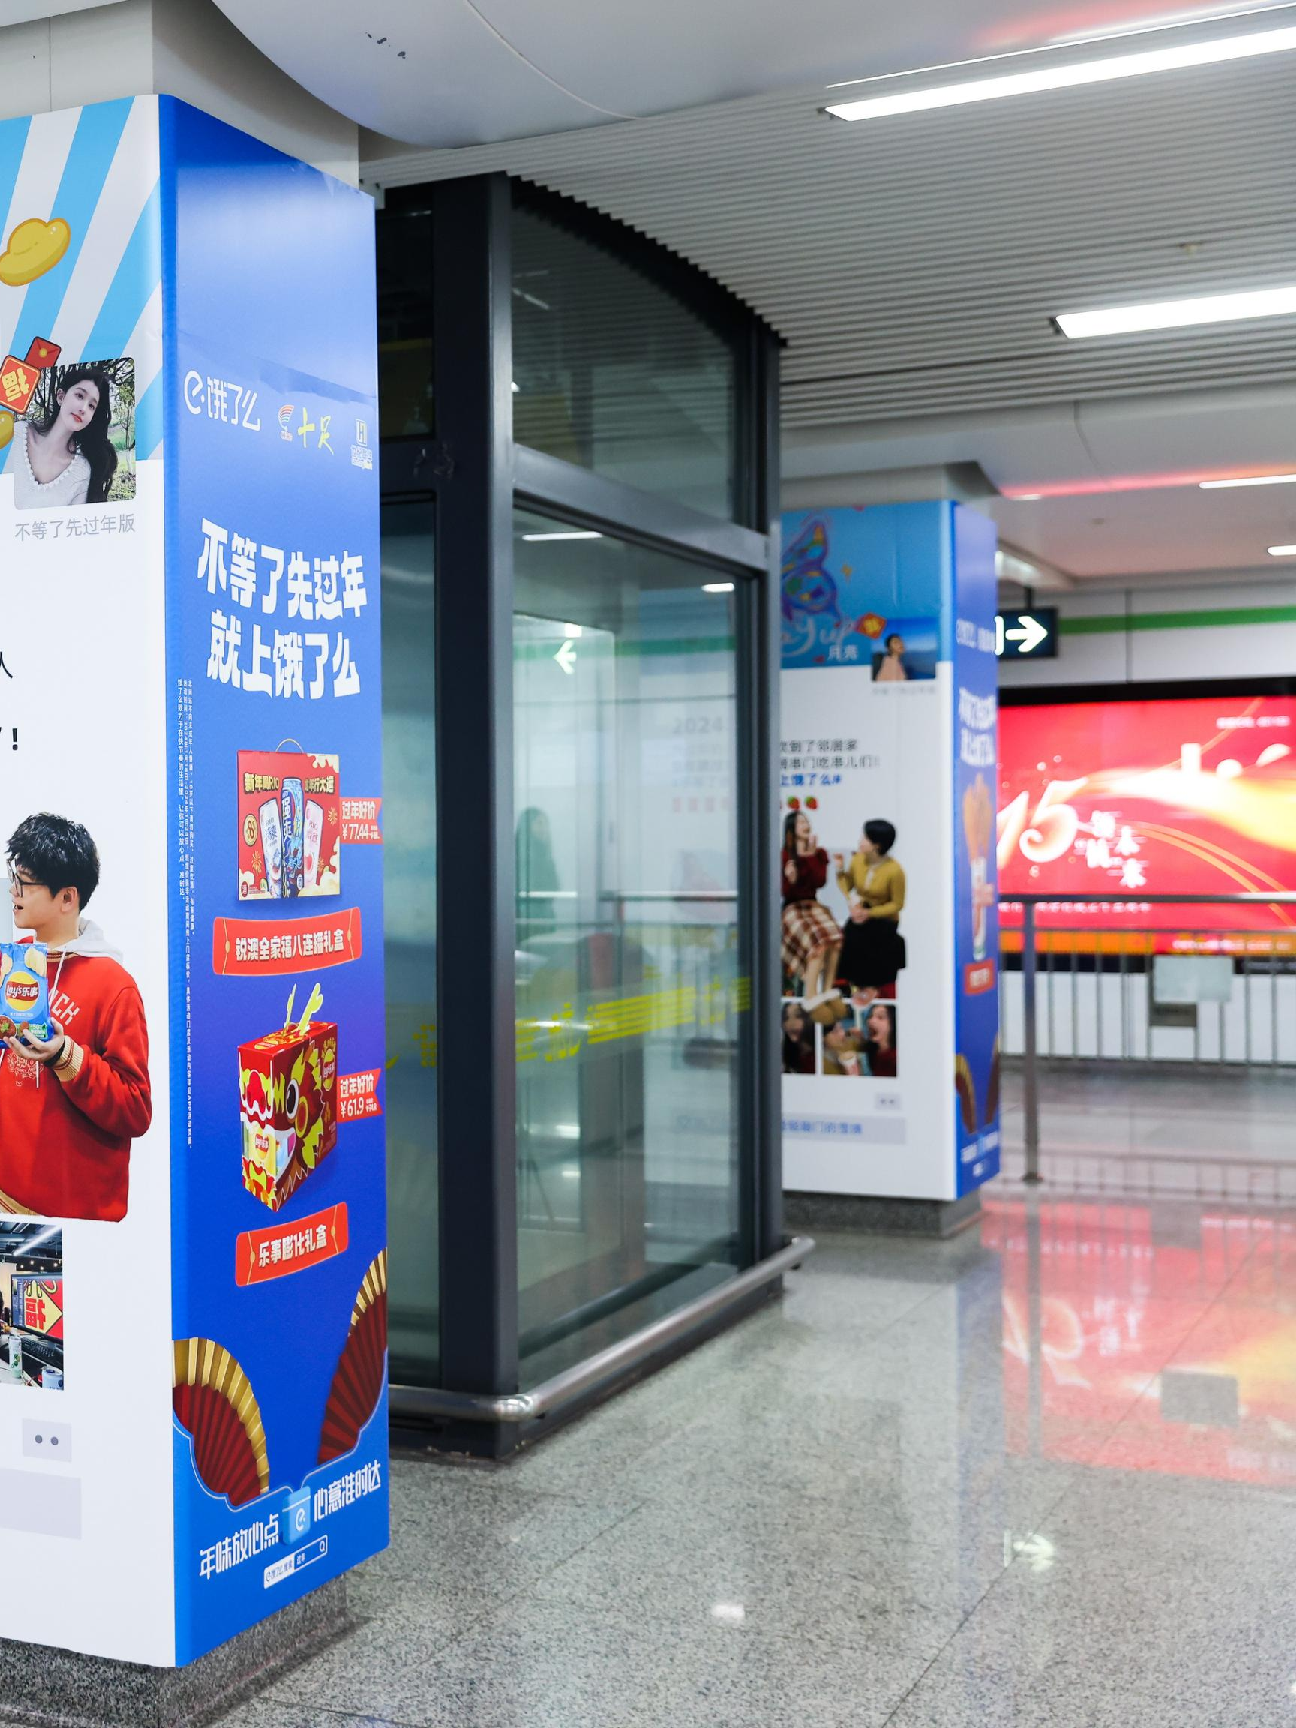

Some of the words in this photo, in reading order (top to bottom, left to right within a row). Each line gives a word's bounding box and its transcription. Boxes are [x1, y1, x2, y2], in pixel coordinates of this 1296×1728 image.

[14, 513, 136, 542] 不等了先过年版
[197, 518, 367, 620] 不等了先过年
[206, 609, 361, 699] 就上饿了么
[342, 801, 375, 820] 过年好价
[340, 1073, 374, 1098] 过年好价
[259, 1224, 327, 1267] 乐事膨化礼盒
[314, 1459, 381, 1522] 心意准时达
[199, 1513, 279, 1580] 年味放心点
